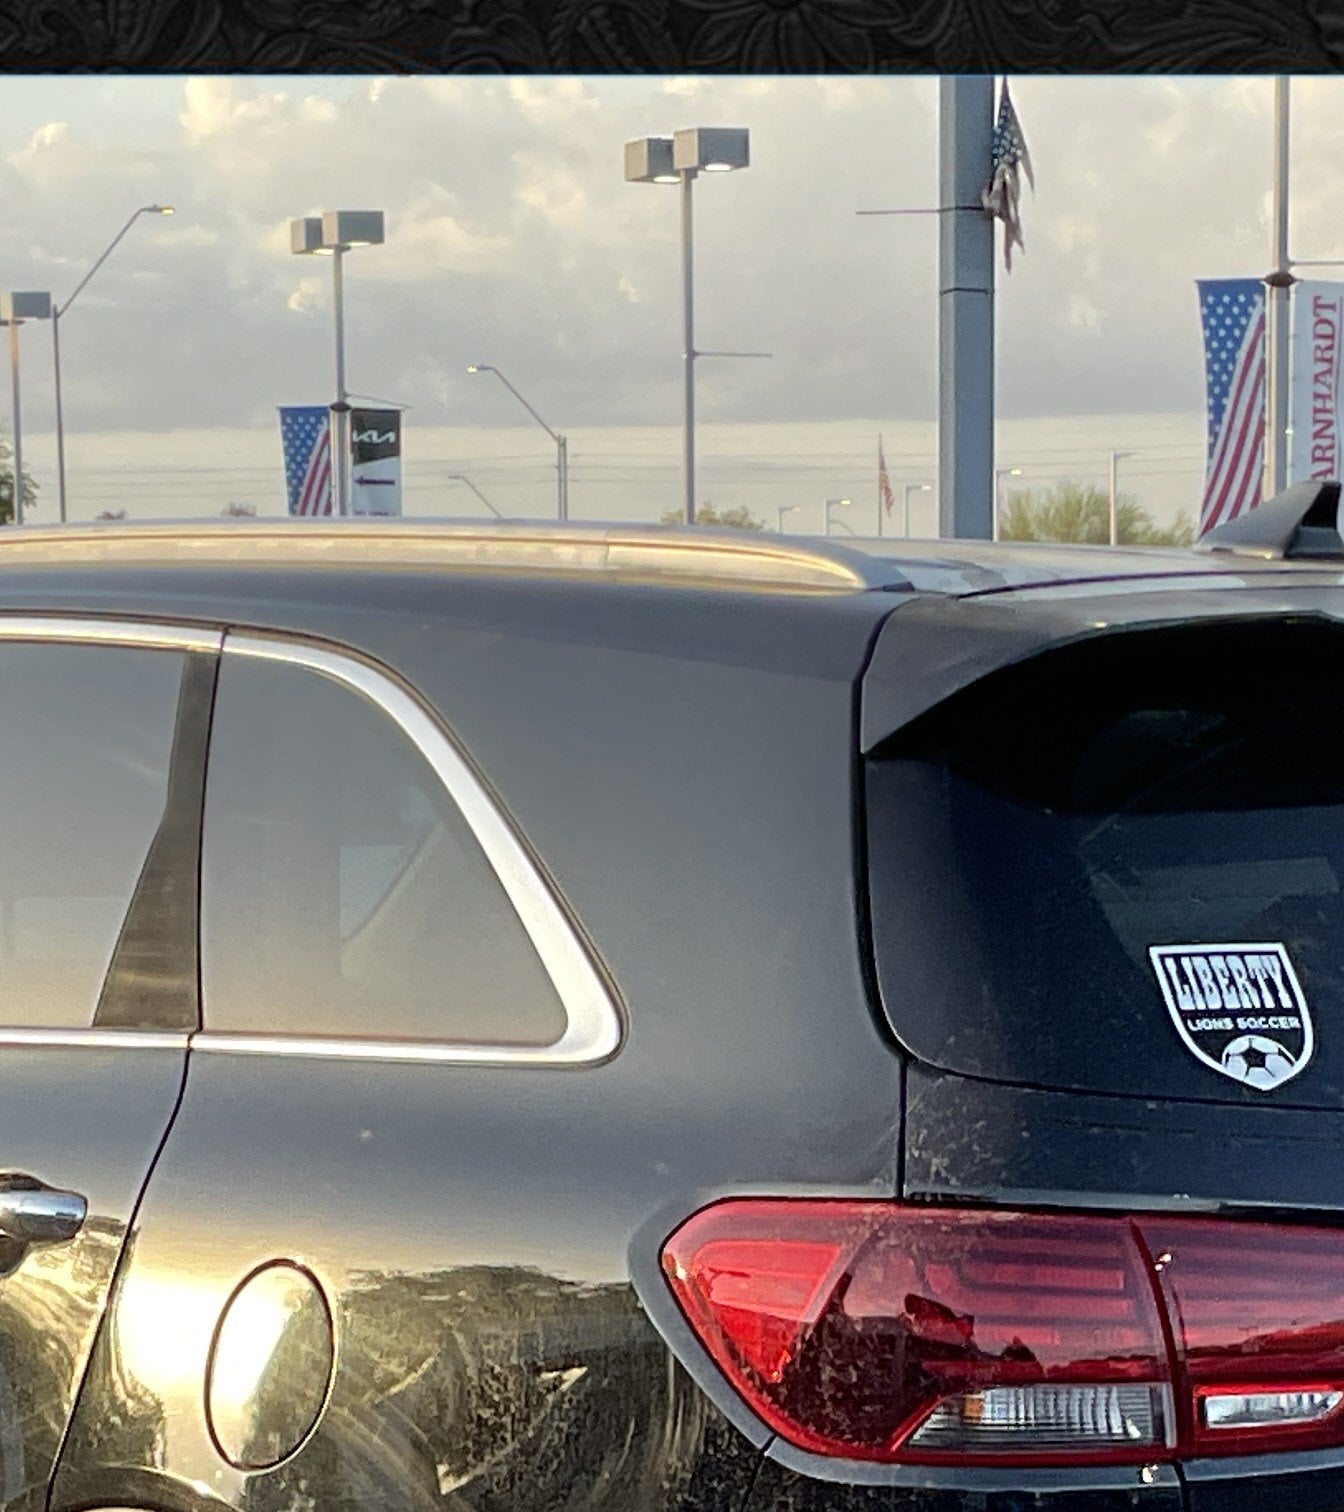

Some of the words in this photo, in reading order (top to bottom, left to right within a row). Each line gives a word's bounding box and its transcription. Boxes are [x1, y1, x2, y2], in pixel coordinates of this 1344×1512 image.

[1311, 295, 1338, 482] ARNHARDT
[1163, 954, 1293, 1011] LIBERTY
[1186, 1018, 1234, 1031] LIONS
[1236, 1016, 1301, 1030] SOCCER
